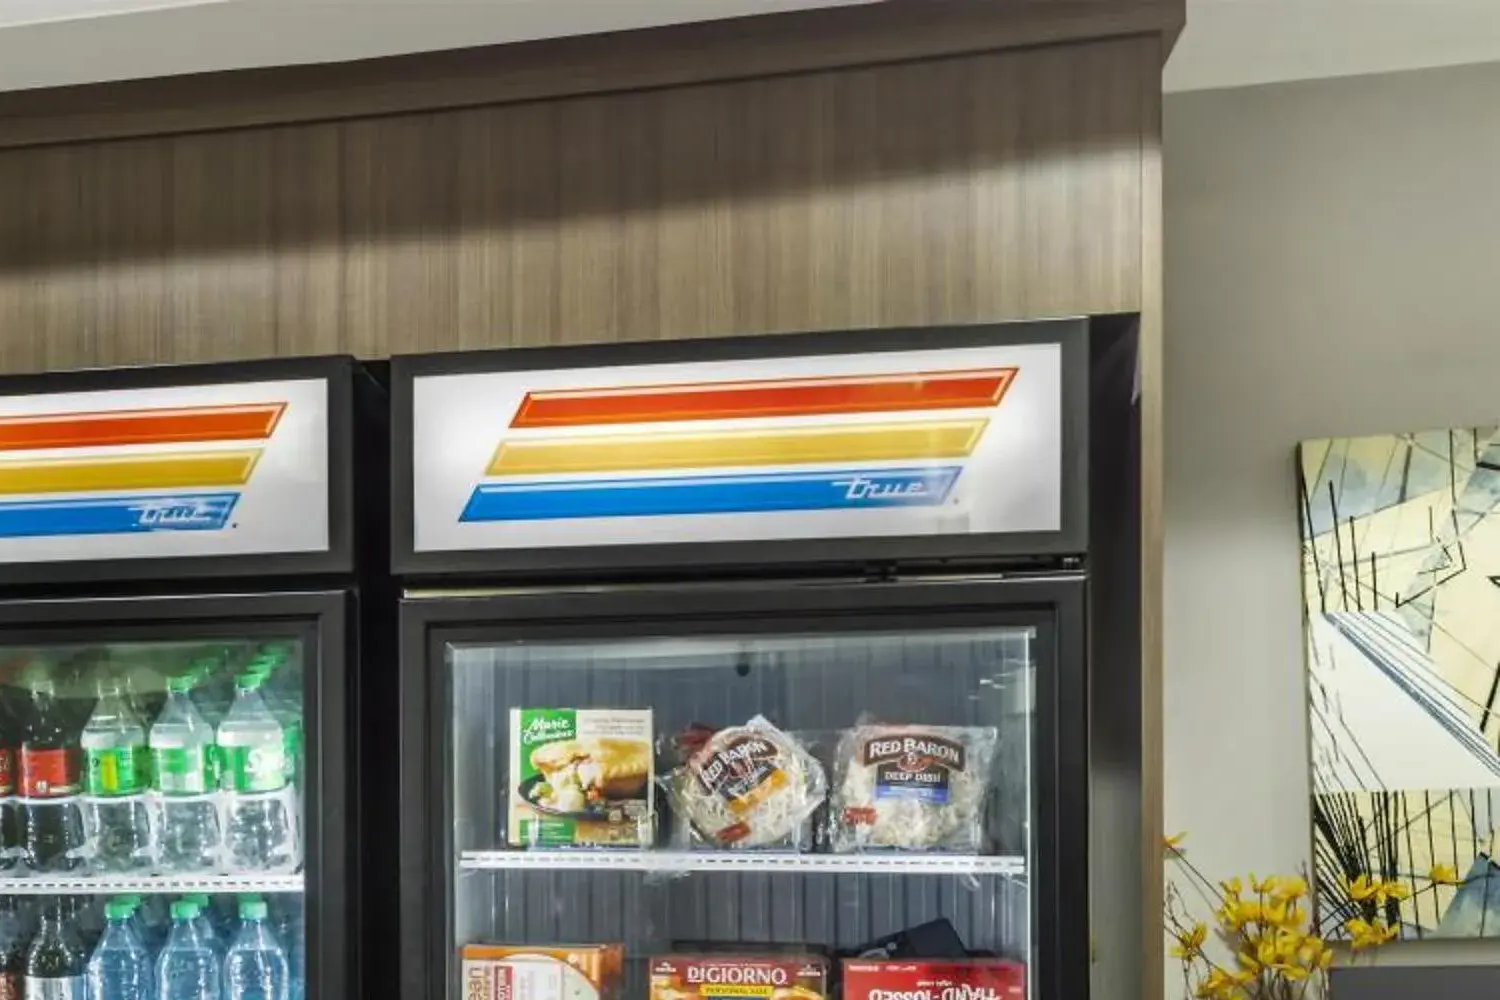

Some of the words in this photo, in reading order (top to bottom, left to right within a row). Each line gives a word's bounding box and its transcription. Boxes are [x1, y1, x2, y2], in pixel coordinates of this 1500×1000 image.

[869, 739, 901, 758] RED
[903, 738, 960, 763] BARON
[701, 759, 724, 790] RED
[719, 738, 769, 764] BARON
[884, 771, 913, 782] DEEP
